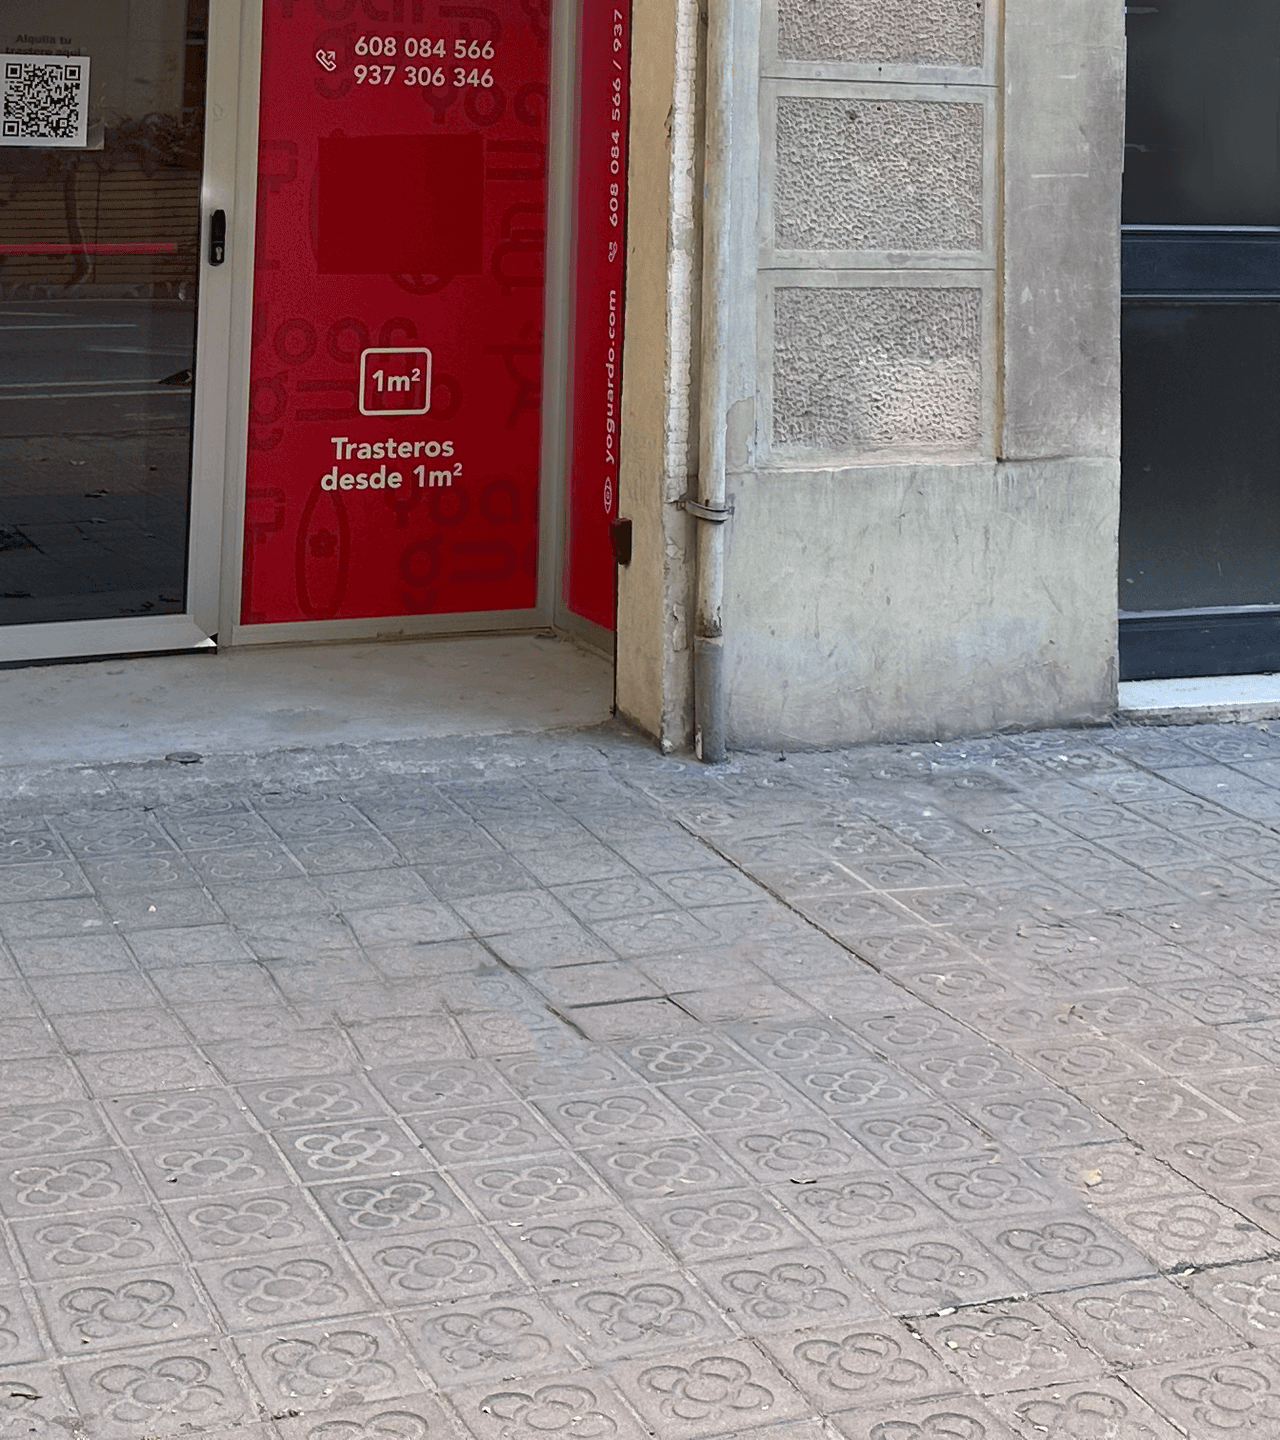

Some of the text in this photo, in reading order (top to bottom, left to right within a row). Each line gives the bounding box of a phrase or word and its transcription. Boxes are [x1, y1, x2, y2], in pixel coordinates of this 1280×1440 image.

[355, 36, 494, 59] 608 084 566
[612, 10, 624, 51] 937
[354, 65, 493, 87] 937 306 346
[611, 78, 622, 121] 566
[610, 131, 621, 174] 084
[609, 183, 620, 226] 608
[605, 290, 617, 463] yoguardo.com
[331, 437, 454, 459] Trasteros
[321, 465, 402, 490] desde
